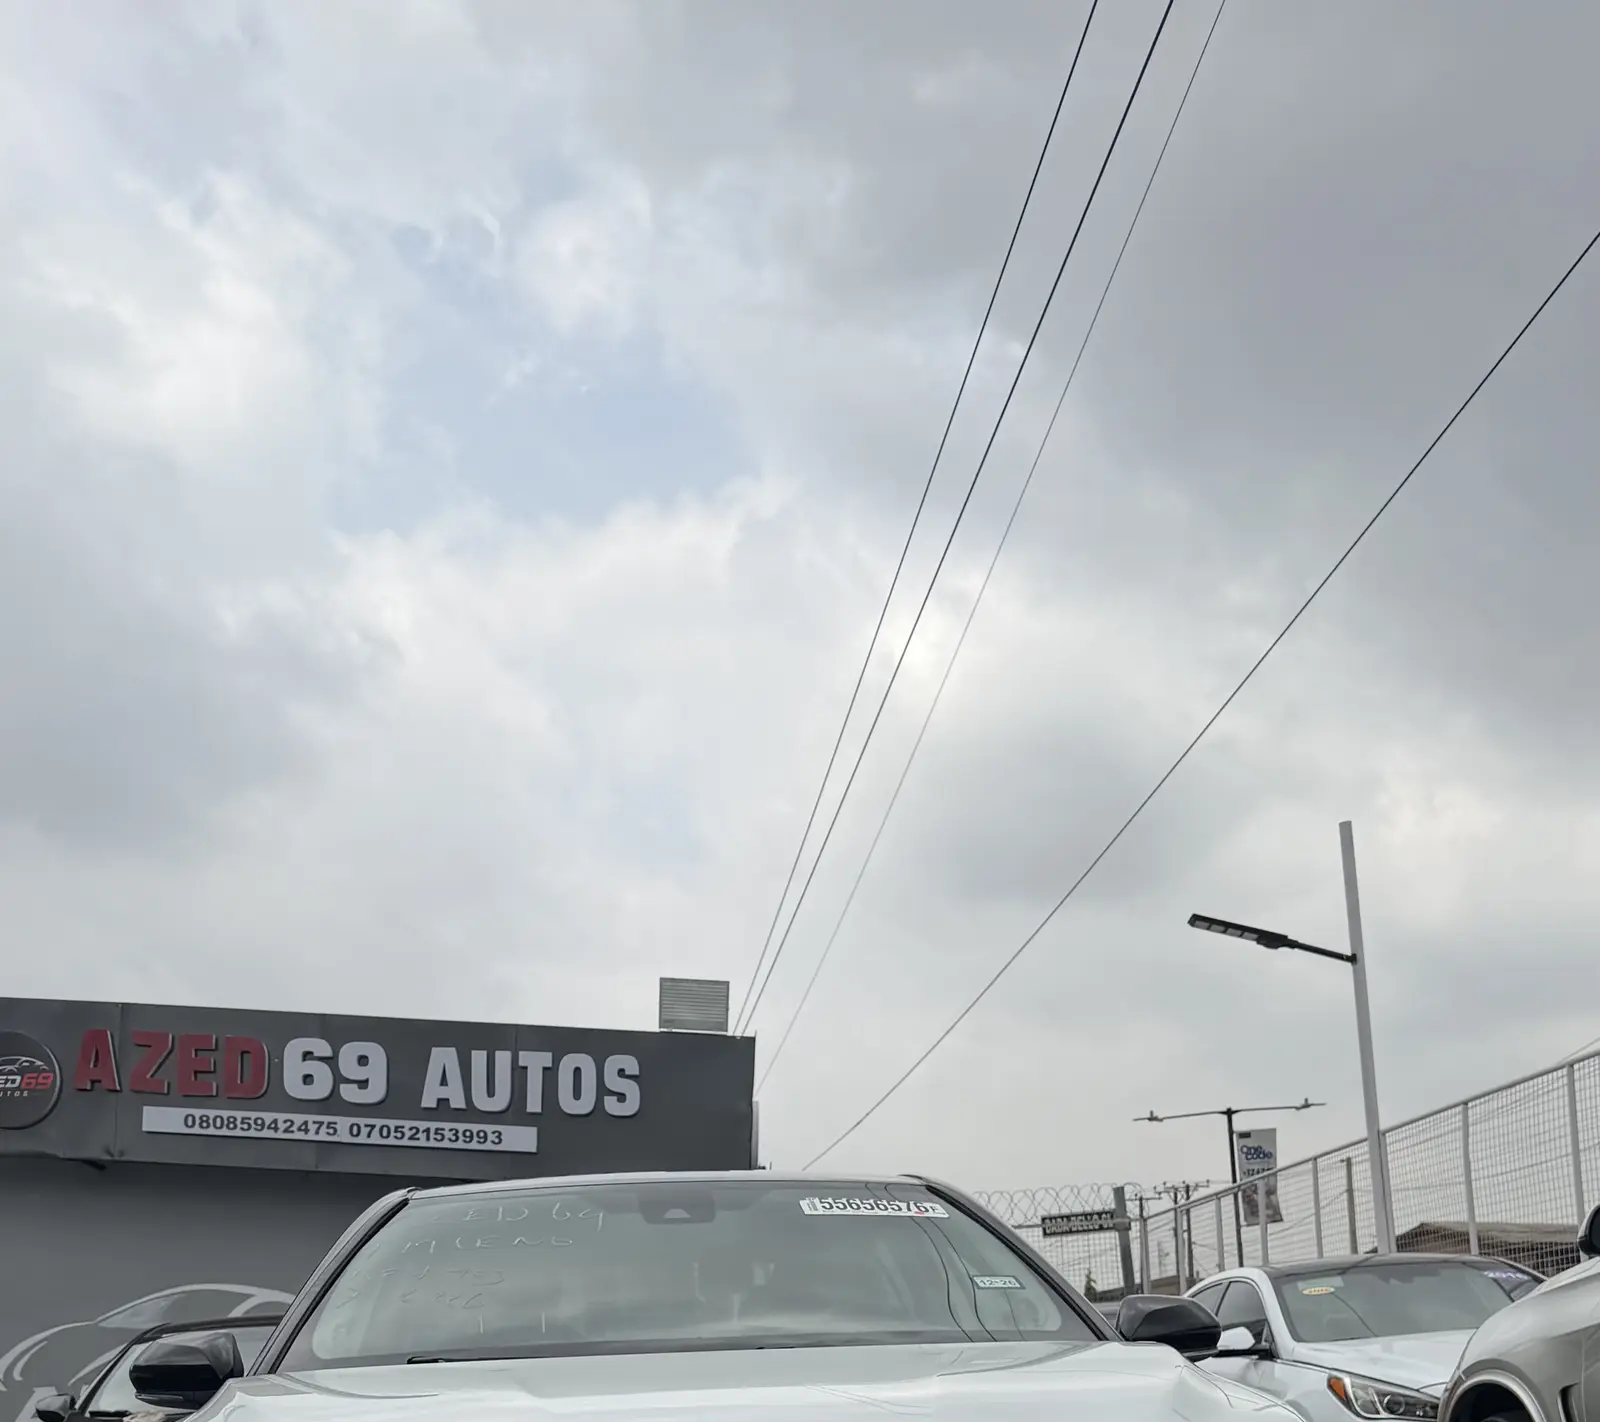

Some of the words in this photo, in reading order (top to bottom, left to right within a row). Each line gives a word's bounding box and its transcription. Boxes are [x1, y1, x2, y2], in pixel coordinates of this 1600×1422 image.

[73, 1028, 269, 1099] AZED
[283, 1037, 389, 1105] 69
[420, 1046, 642, 1117] AUTOS
[183, 1113, 339, 1137] 08085942475
[348, 1122, 504, 1146] 07052153993
